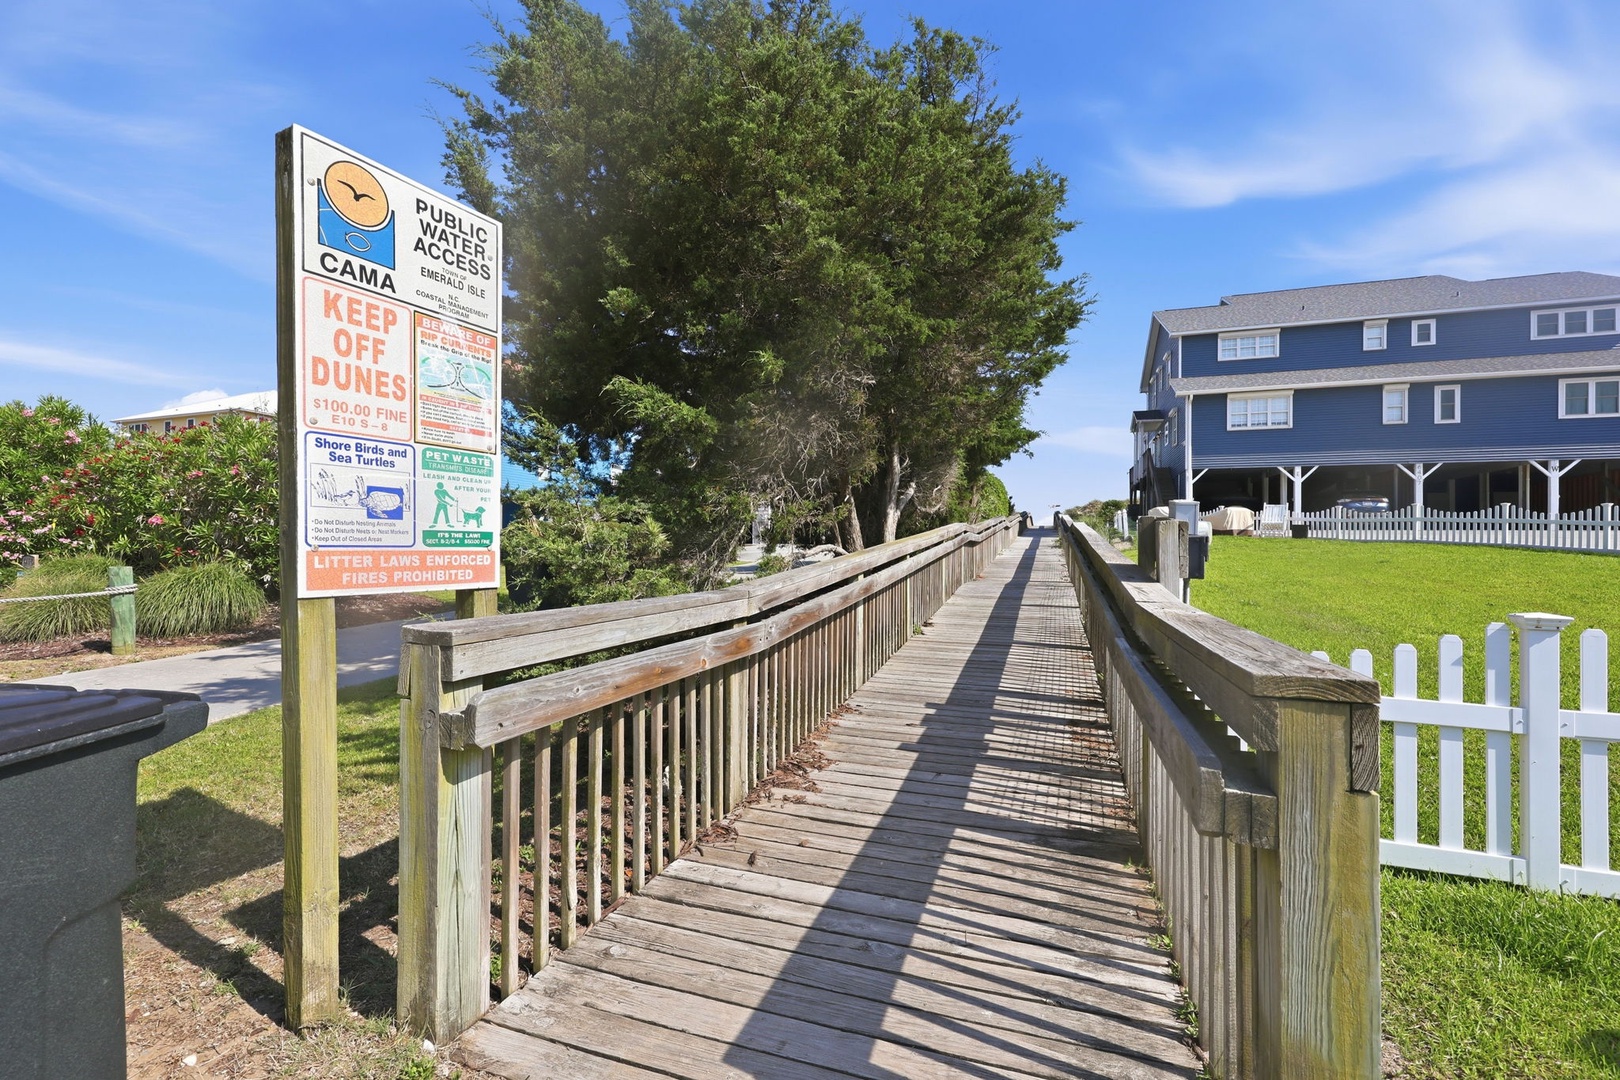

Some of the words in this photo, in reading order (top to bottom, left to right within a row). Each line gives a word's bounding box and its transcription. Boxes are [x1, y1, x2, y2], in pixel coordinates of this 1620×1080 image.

[416, 198, 487, 244] PUBLIC
[419, 219, 485, 260] WATER
[414, 238, 490, 280] ACCESS
[320, 252, 396, 294] CAMA
[421, 267, 464, 290] EMERALD
[468, 284, 485, 299] ISLE
[442, 267, 458, 278] TOWN
[416, 290, 445, 304] COASTAL
[448, 301, 488, 318] MANAGEMENT
[449, 294, 459, 302] N.C.
[324, 289, 397, 334] KEEP
[439, 304, 469, 318] PROGRAM
[421, 331, 437, 341] RIP
[422, 318, 472, 340] BEWARE
[476, 335, 491, 345] OF
[334, 328, 385, 364] OFF
[312, 356, 406, 401] DUNES
[314, 399, 370, 416] $100.00
[377, 408, 407, 423] FINE
[332, 415, 356, 427] E10
[315, 437, 350, 451] Shore
[355, 440, 384, 456] Birds
[388, 447, 407, 458] and
[426, 451, 449, 460] PET
[452, 454, 490, 466] WASTE
[329, 451, 352, 464] Sea
[356, 454, 395, 468] Turtles
[429, 462, 462, 471] TRANSMITS
[314, 555, 372, 568] LITTER
[381, 555, 420, 568] LAWS
[427, 552, 490, 566] ENFORCED
[342, 571, 387, 585] FIRES
[394, 569, 473, 583] PROHIBITED
